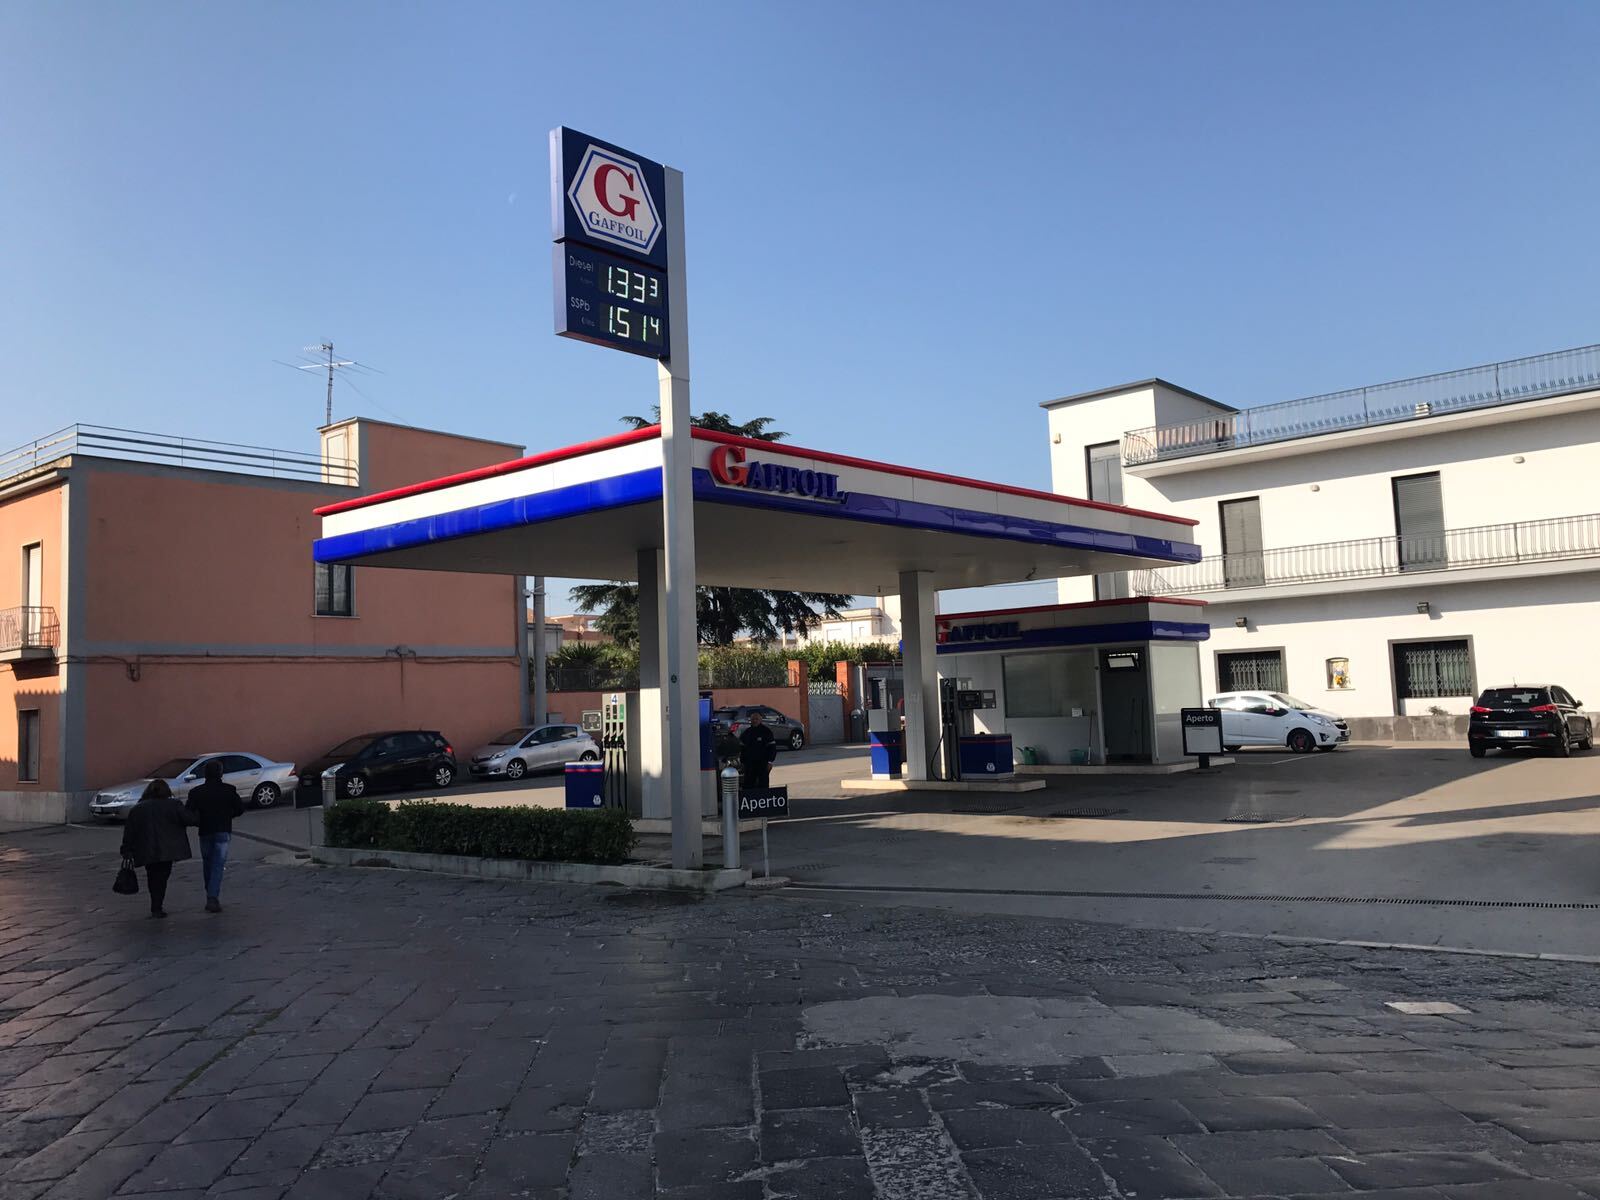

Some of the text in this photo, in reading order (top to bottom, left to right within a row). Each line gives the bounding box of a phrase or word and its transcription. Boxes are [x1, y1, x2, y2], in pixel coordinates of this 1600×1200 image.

[594, 164, 640, 221] G
[589, 211, 647, 242] GAFFOIL
[569, 255, 594, 272] Diesel
[570, 296, 591, 312] SSPb
[709, 444, 846, 503] GAFFOIL
[611, 694, 618, 704] 4
[1185, 714, 1214, 724] Aperto
[740, 795, 786, 812] Aperto
